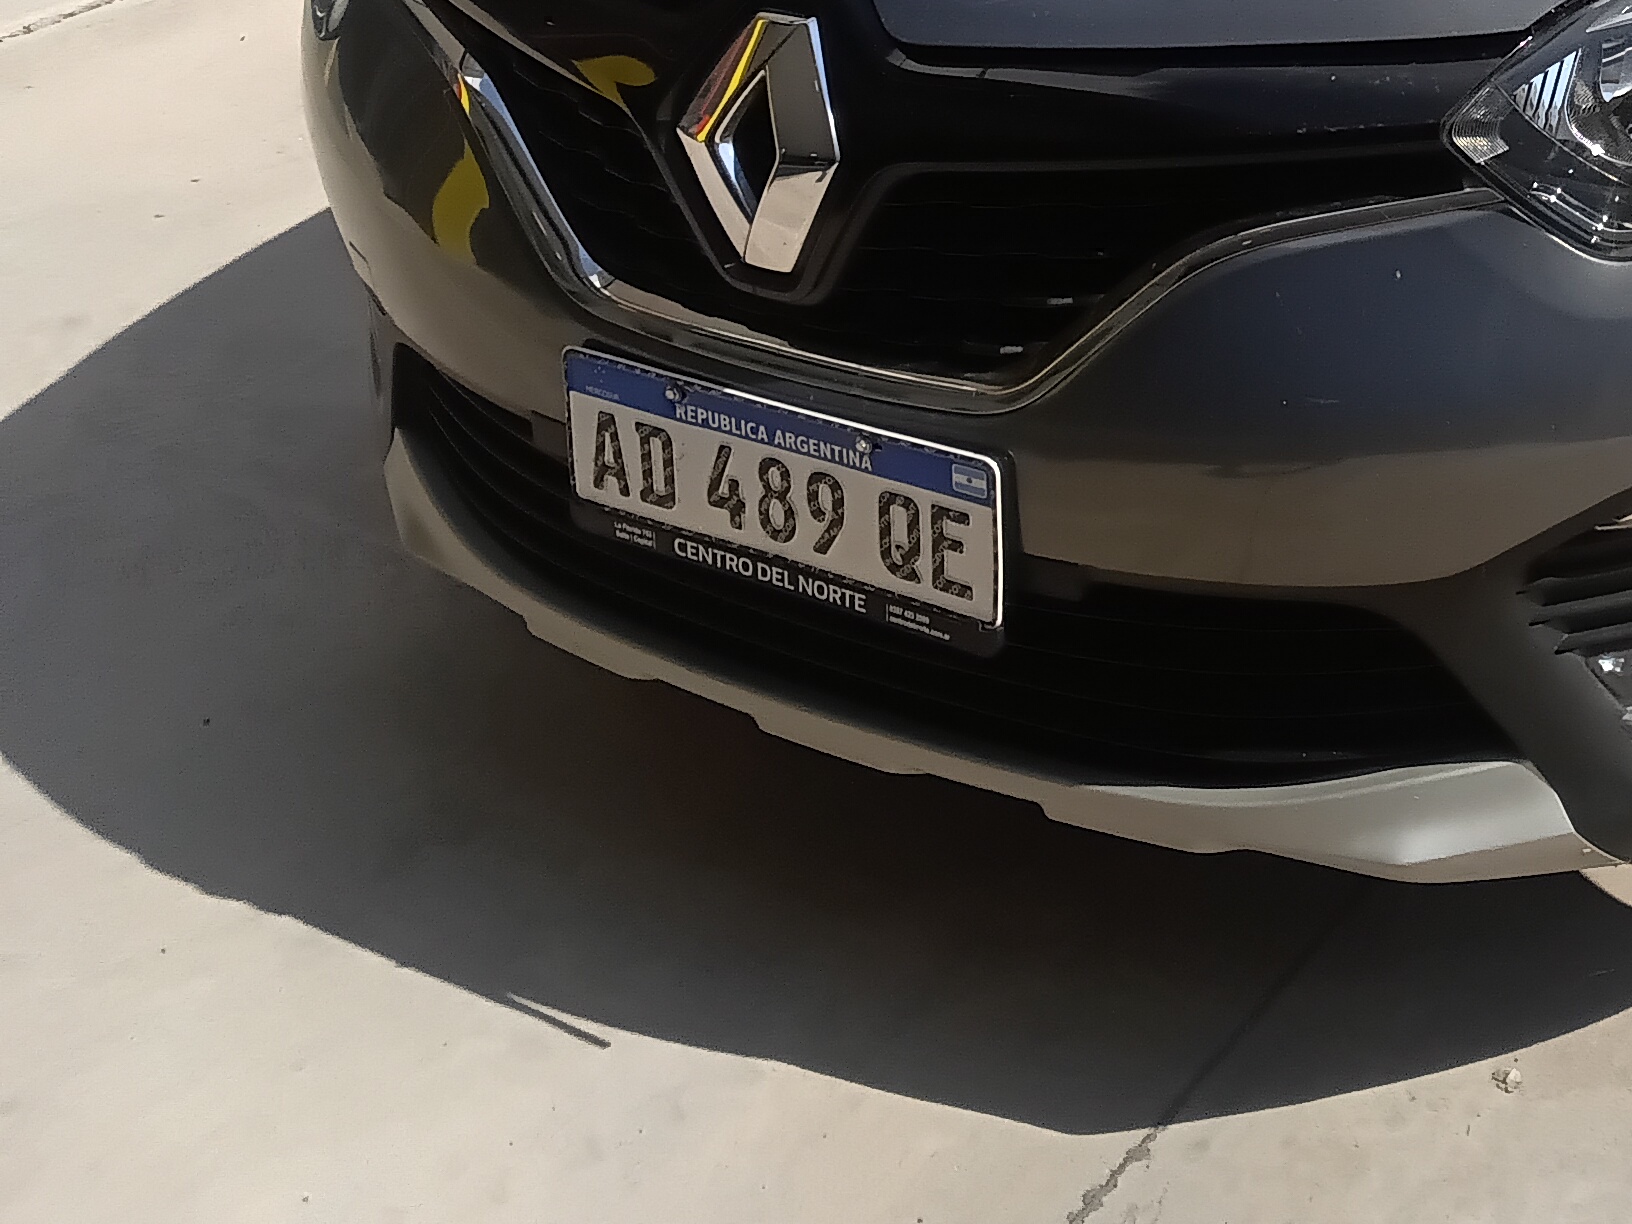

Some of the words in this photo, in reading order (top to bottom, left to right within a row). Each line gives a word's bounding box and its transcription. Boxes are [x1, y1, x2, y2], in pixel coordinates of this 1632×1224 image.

[674, 403, 769, 443] REPUBLICA
[773, 429, 873, 472] ARGENTINA
[593, 410, 677, 510] AD
[707, 443, 846, 556] 489
[878, 490, 974, 602] QE
[673, 537, 753, 577] CENTRO
[756, 561, 795, 591] DEL
[797, 574, 867, 614] NORTE
